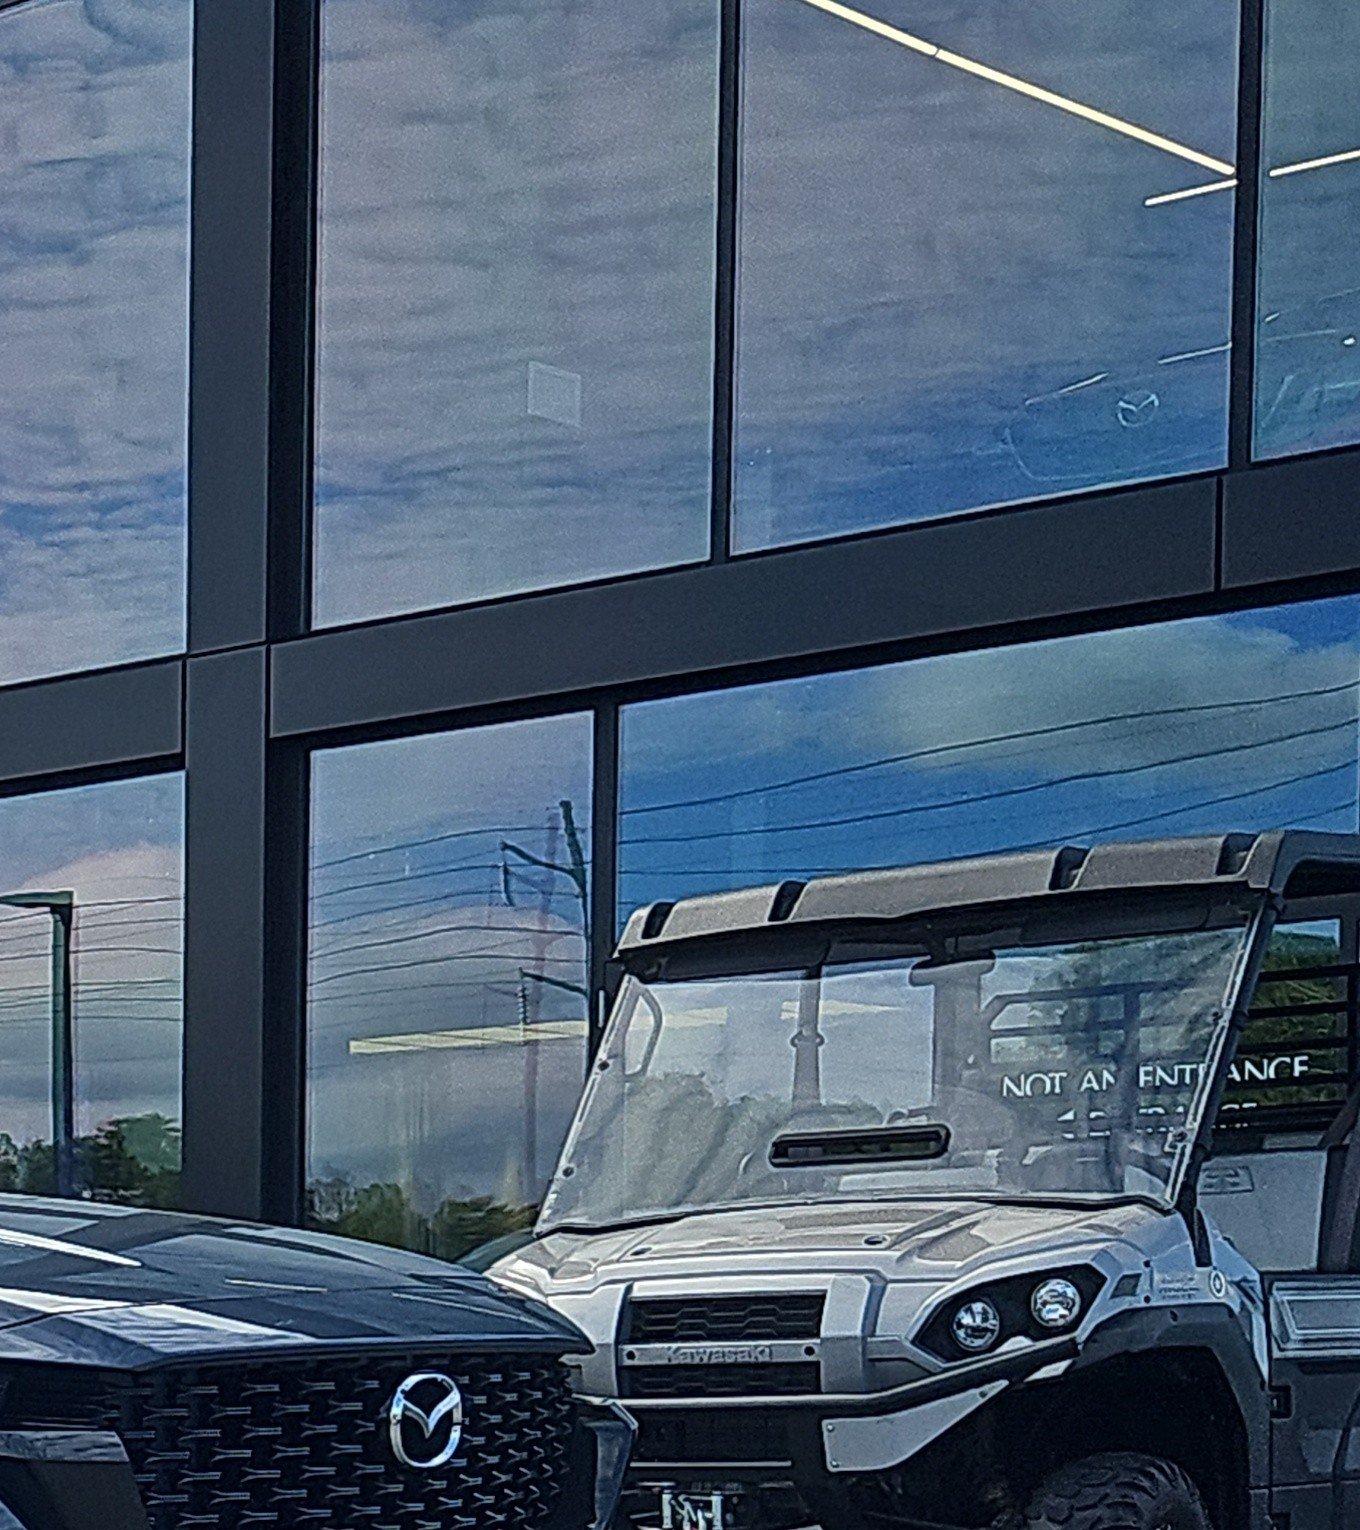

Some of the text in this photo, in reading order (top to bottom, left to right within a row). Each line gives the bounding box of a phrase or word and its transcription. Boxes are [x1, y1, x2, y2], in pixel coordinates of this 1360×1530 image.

[1002, 1072, 1067, 1097] NOT
[1079, 1068, 1117, 1093] AN
[666, 1345, 774, 1364] Kawasaki
